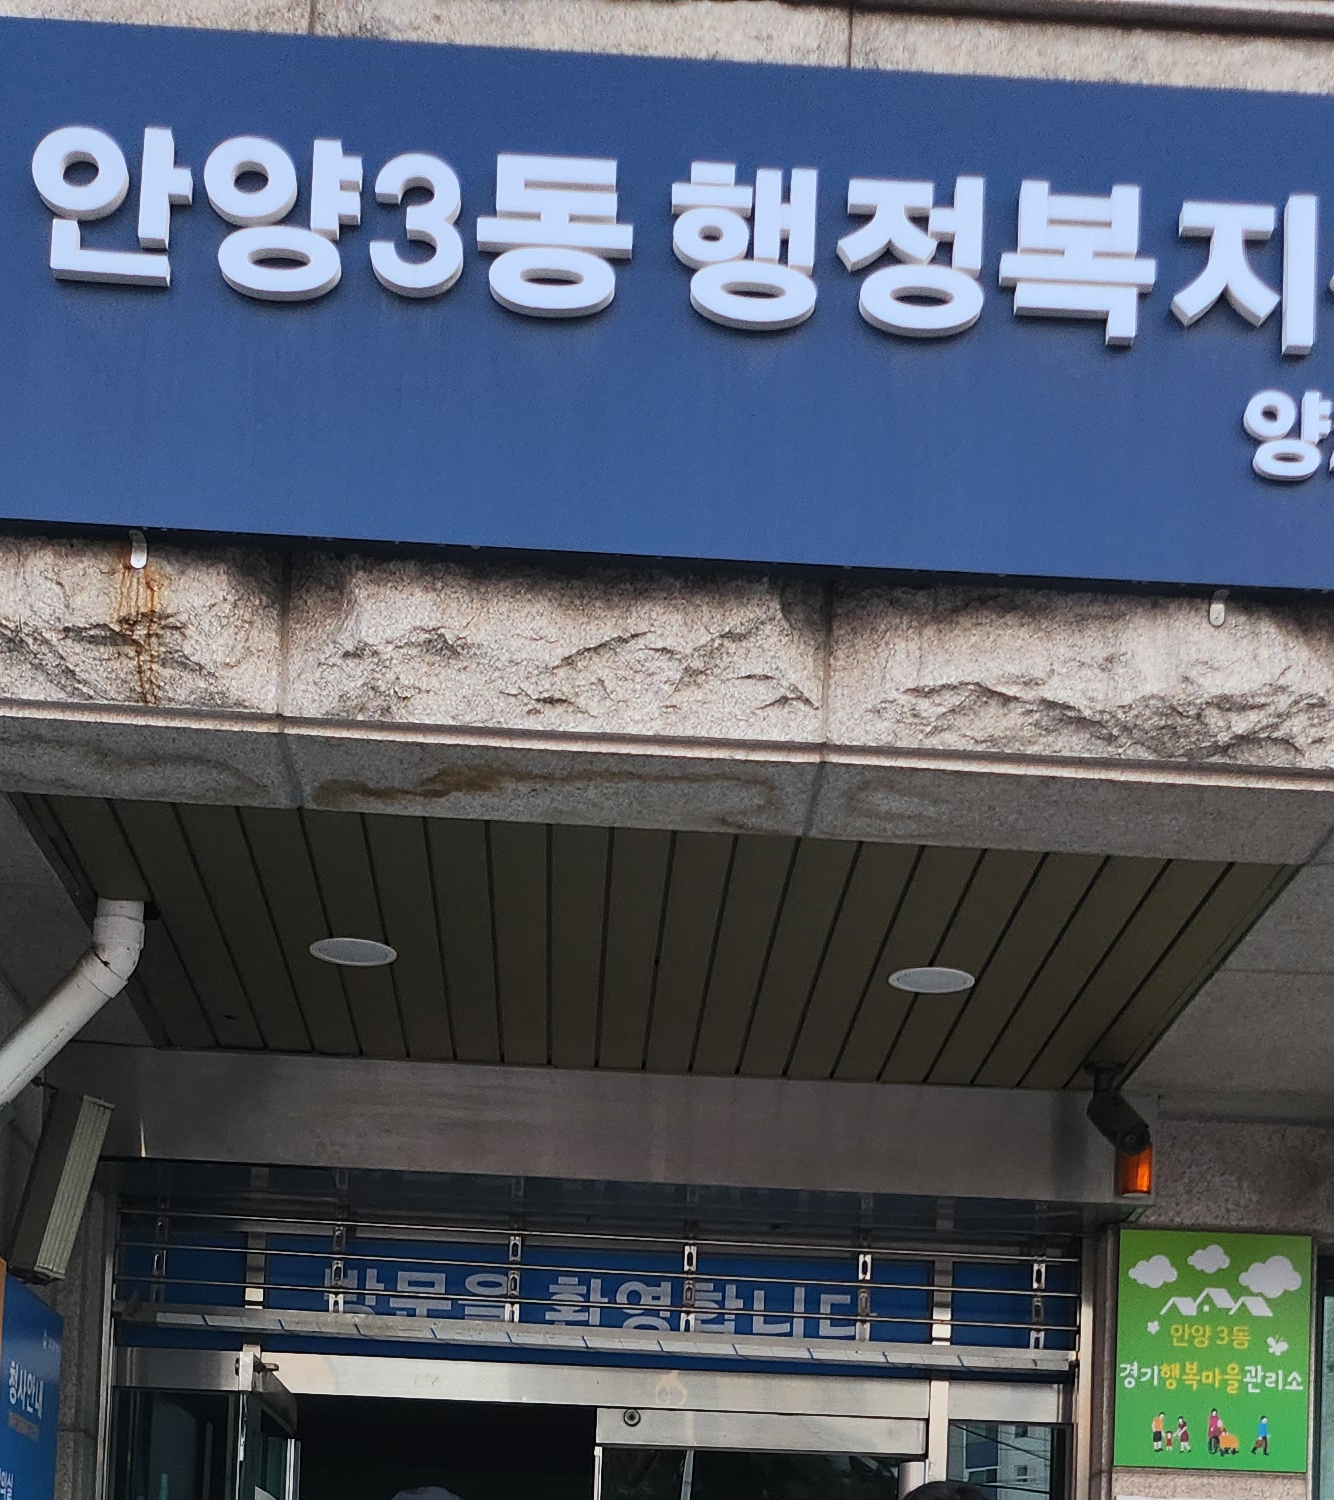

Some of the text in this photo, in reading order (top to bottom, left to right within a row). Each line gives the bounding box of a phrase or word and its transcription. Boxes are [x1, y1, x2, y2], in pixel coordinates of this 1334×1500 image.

[32, 125, 633, 318] 안양3동
[1170, 1323, 1251, 1349] 안양 3동
[8, 1361, 44, 1420] 청사안내
[1119, 1361, 1304, 1395] 경기행복마을관리소
